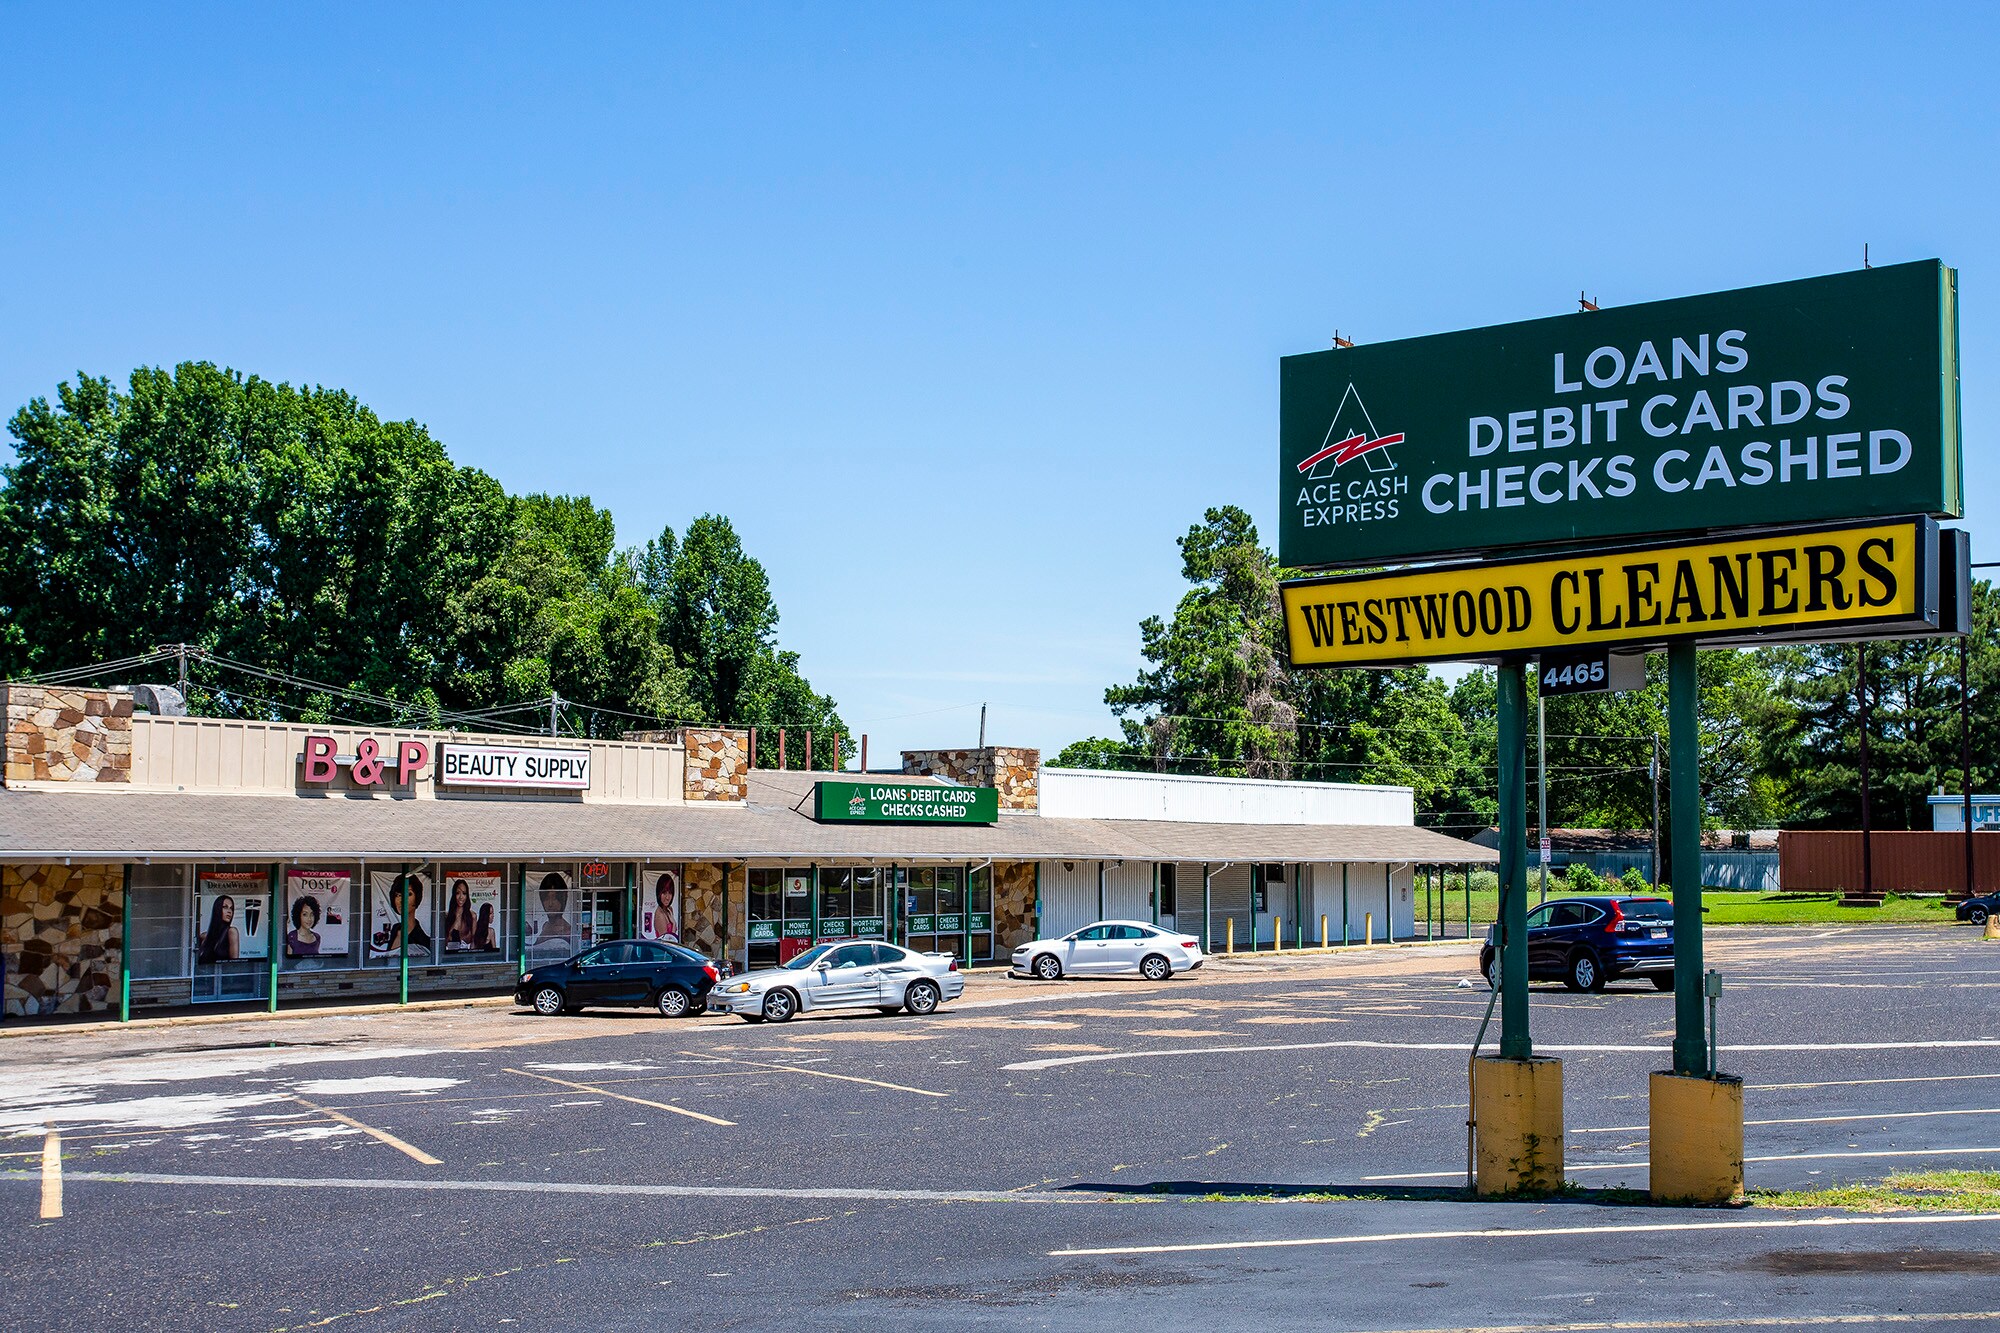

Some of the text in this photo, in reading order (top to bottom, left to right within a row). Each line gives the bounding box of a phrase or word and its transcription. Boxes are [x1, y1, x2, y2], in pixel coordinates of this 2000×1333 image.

[1554, 328, 1749, 394] LOANS
[1468, 374, 1850, 457] DEBIT CARDS
[1421, 429, 1913, 514] CHECKS CASHED
[1297, 475, 1409, 506] ACE CASH
[1303, 498, 1400, 527] EXPRESS
[1300, 537, 1898, 649] WESTWOOD CLEANERS
[1543, 660, 1606, 688] 4465
[303, 735, 429, 786] B & P
[445, 753, 588, 779] BEAUTY SUPPLY
[870, 787, 976, 803] LOANS DEBIT CARDS
[881, 803, 967, 817] CHECKS CASHED
[583, 863, 609, 876] OPEN
[301, 878, 331, 890] POSE
[755, 923, 773, 931] DEBIT
[913, 917, 929, 925] DEBIT
[939, 916, 959, 924] CHECKS
[754, 930, 774, 938] CARDS
[823, 927, 845, 935] CASHED
